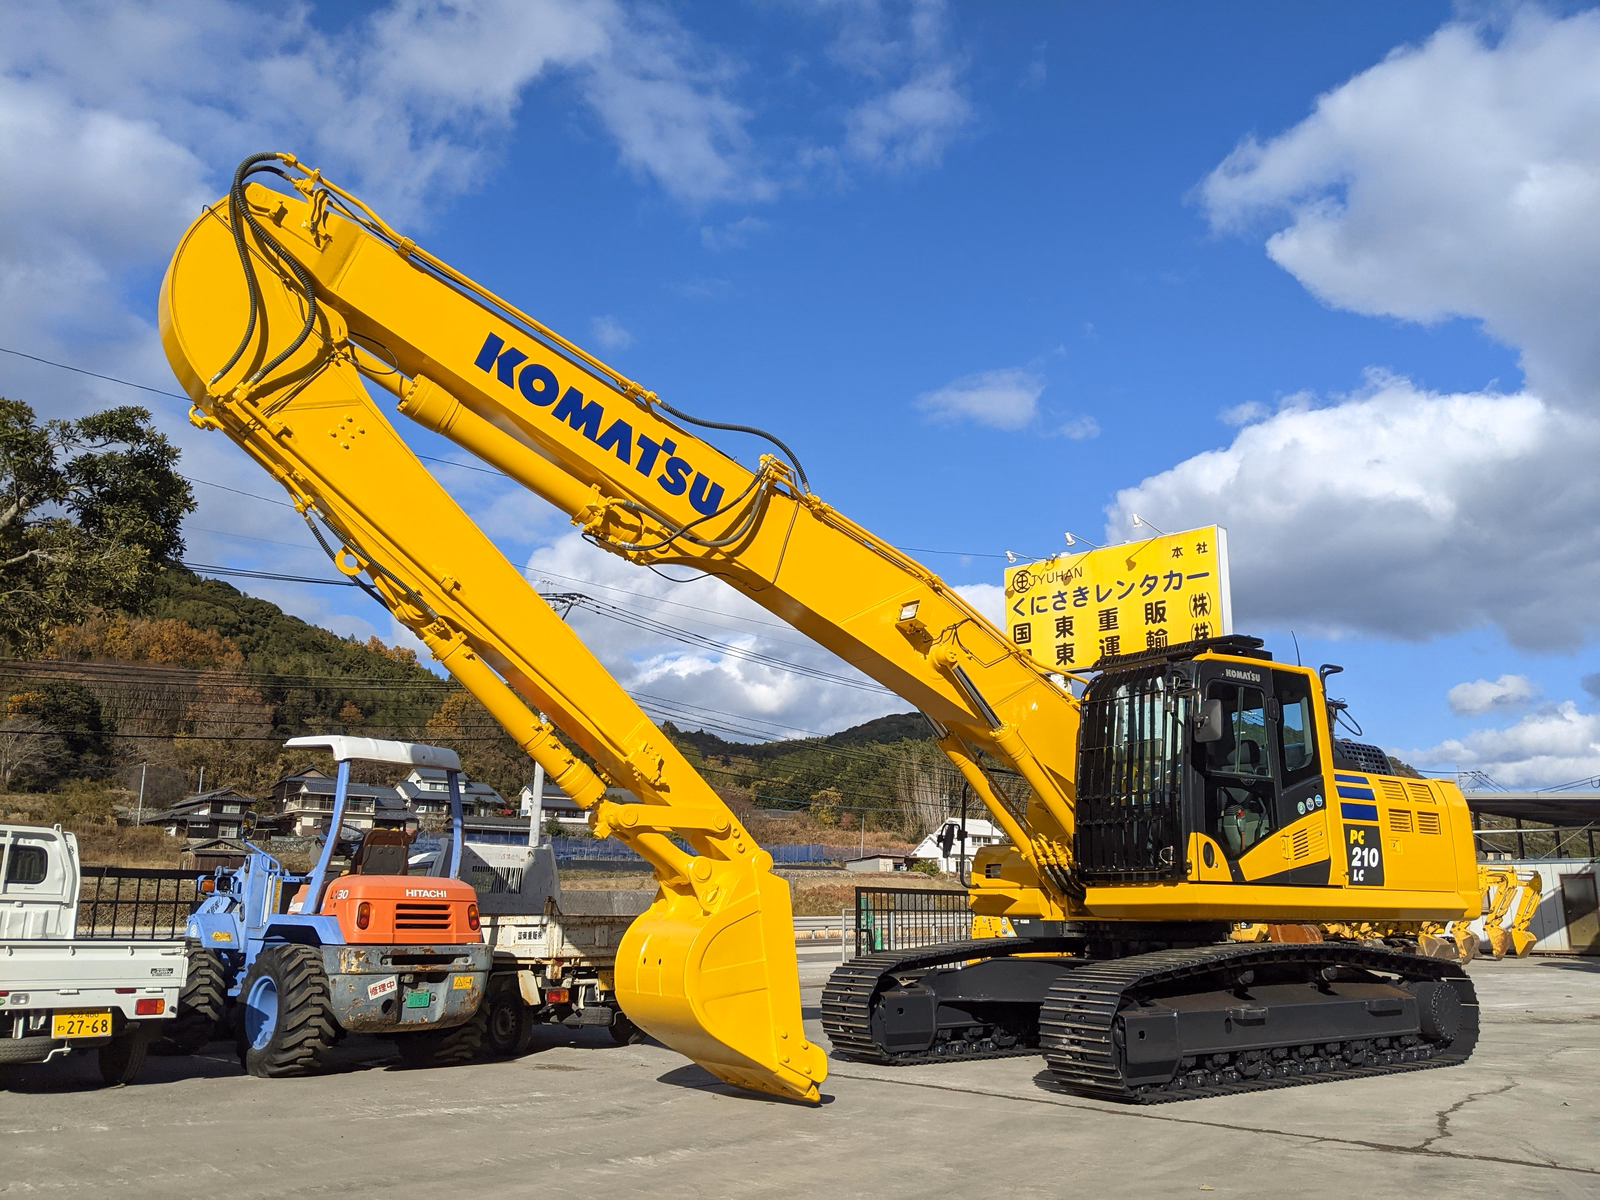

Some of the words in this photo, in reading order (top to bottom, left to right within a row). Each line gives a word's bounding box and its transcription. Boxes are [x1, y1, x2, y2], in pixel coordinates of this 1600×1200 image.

[474, 331, 726, 517] KOMATSU
[1171, 541, 1209, 559] 本社
[1028, 566, 1084, 588] JYUHAN
[1012, 570, 1210, 617] くにさきレンタカー
[1225, 668, 1261, 683] KOMATSU
[1349, 829, 1365, 845] PC
[1351, 846, 1379, 868] 210
[1352, 869, 1364, 882] LC
[405, 889, 447, 898] HITACHI
[67, 1019, 108, 1034] 27-68
